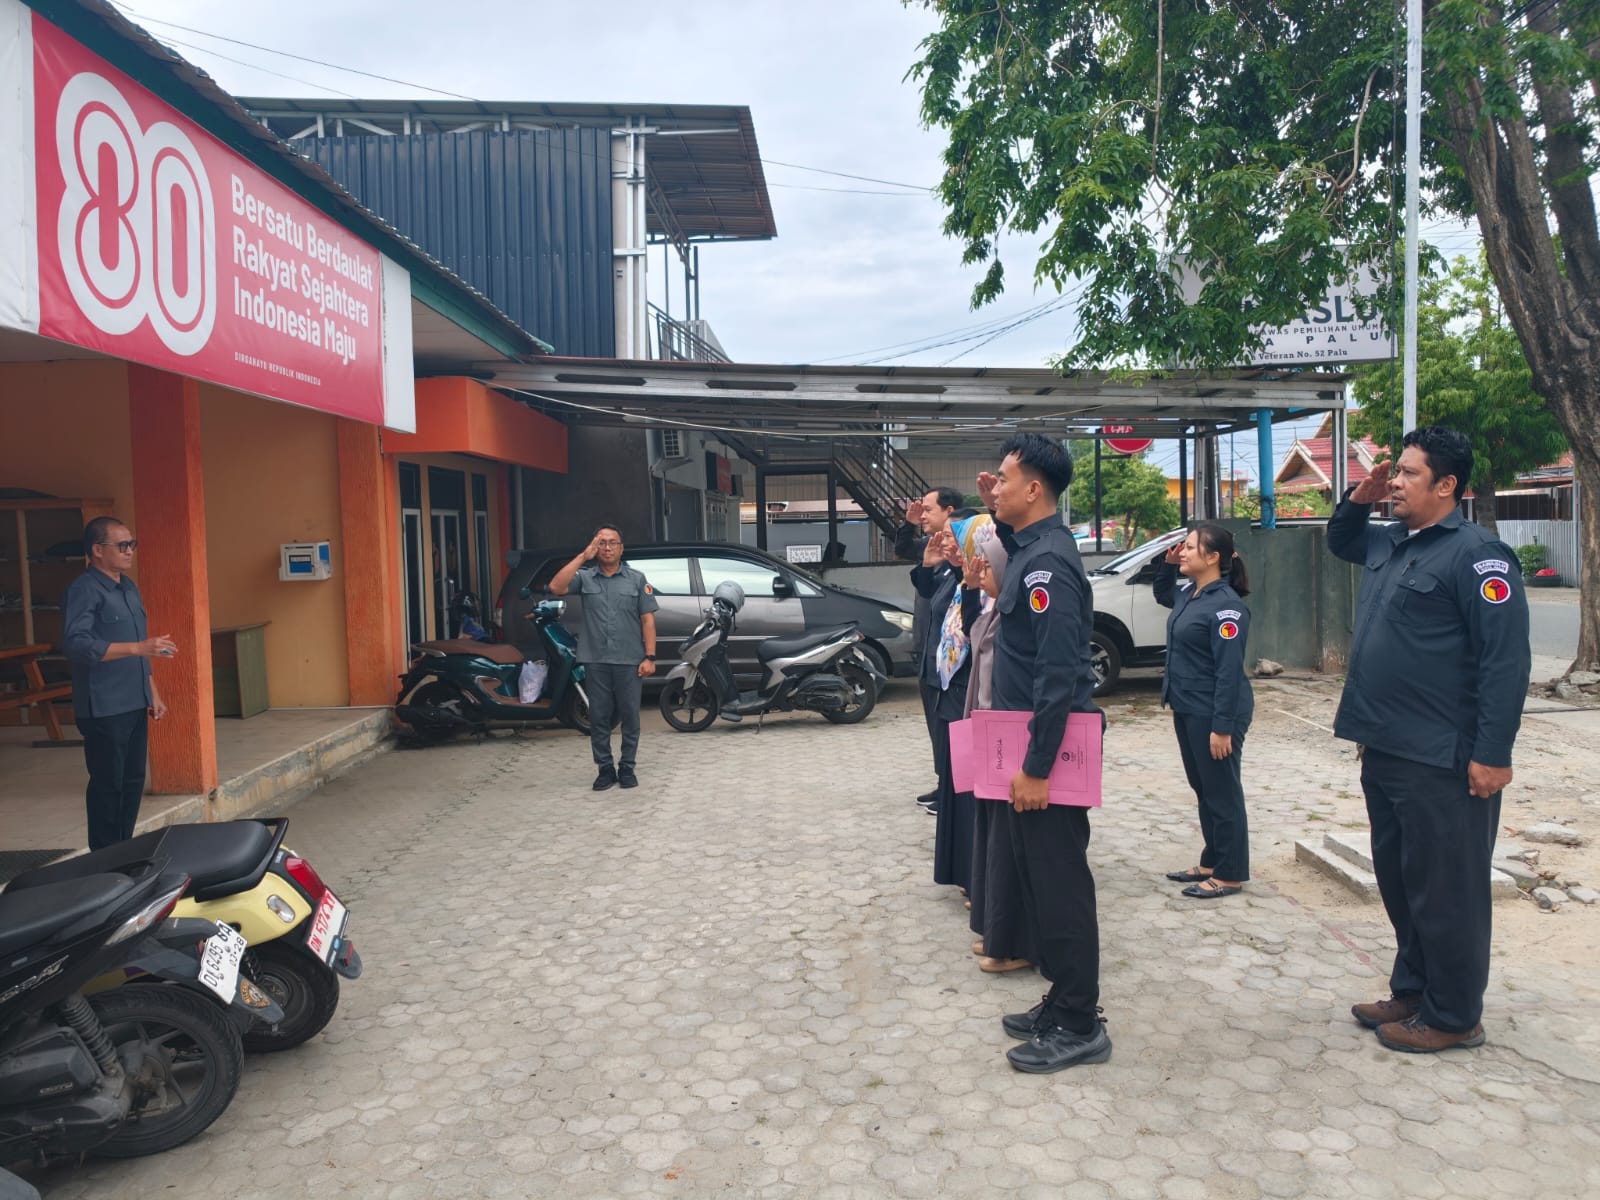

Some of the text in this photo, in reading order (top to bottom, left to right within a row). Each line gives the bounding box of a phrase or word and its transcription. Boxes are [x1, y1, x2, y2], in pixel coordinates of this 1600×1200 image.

[56, 72, 216, 356] 80
[231, 173, 373, 292] Bersatu Berdaulat
[232, 224, 369, 328] Rakyat Sejahtera
[234, 276, 356, 366] Indonesia Maju
[1293, 325, 1347, 334] PEMILIHAN
[1327, 348, 1348, 356] Palu
